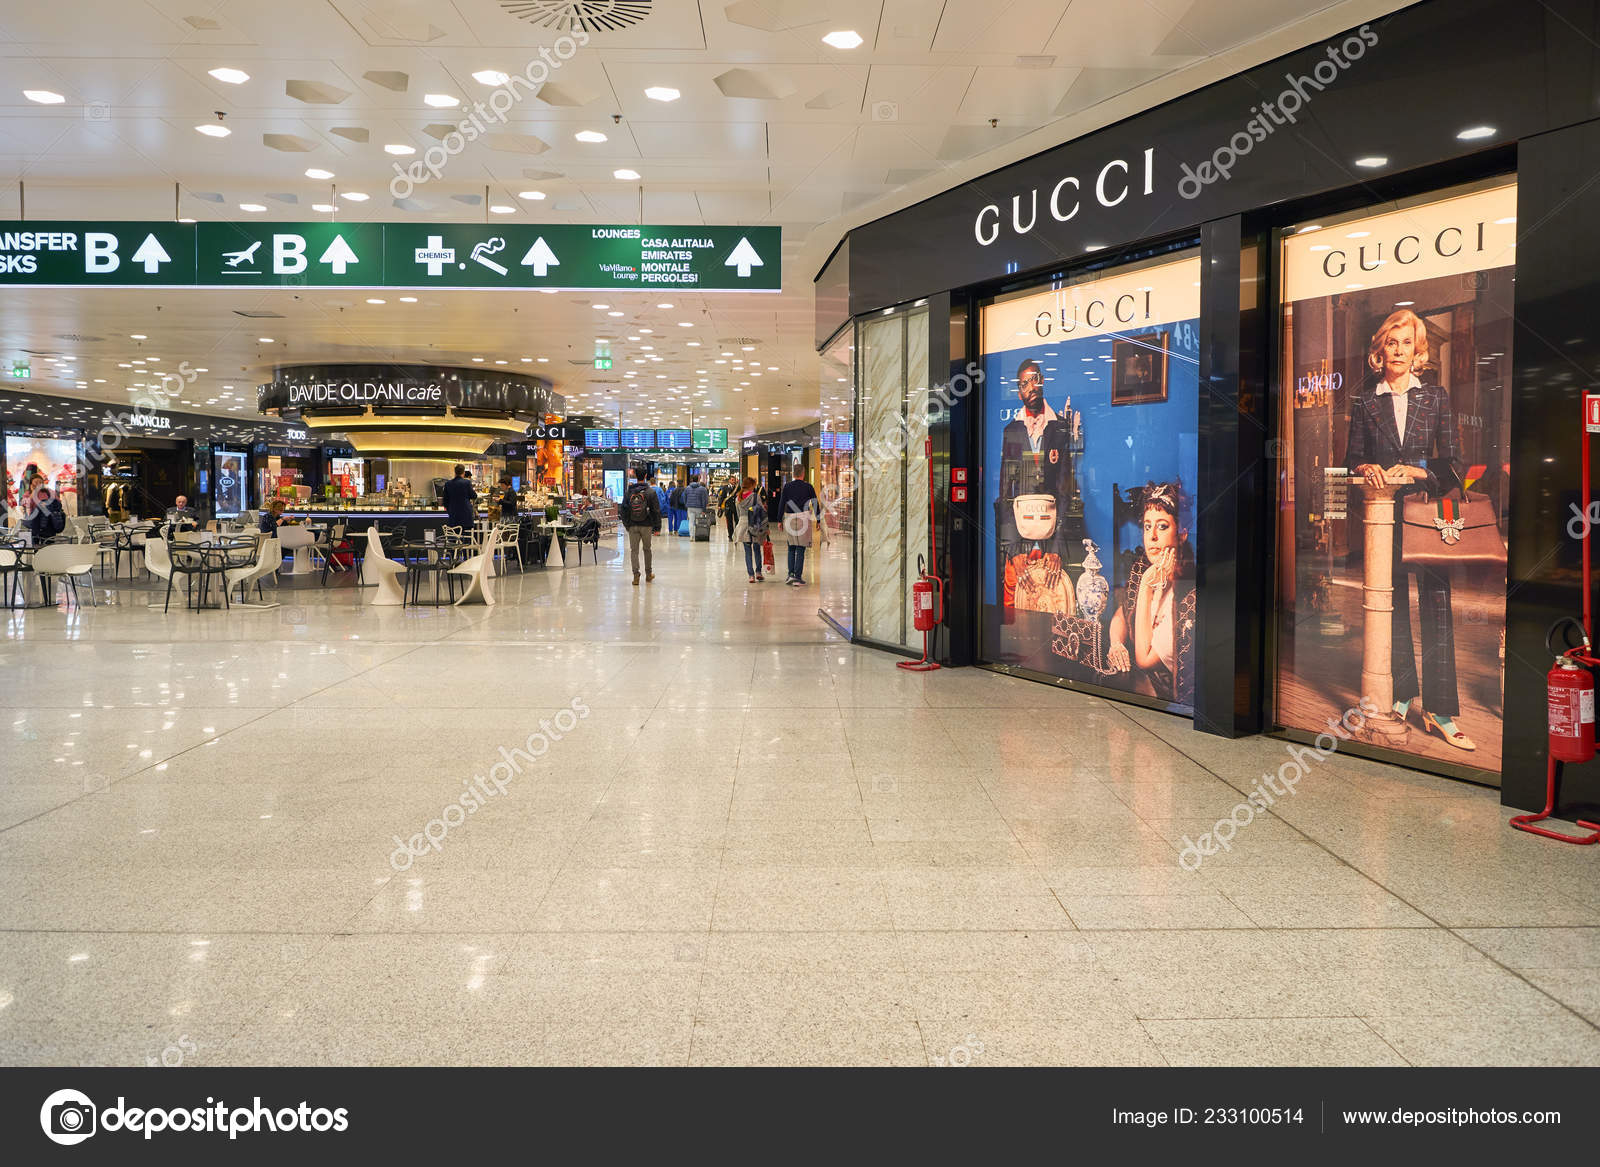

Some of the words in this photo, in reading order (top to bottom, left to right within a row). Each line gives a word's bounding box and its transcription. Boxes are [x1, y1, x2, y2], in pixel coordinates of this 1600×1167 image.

[975, 147, 1154, 246] GUCCI
[592, 229, 641, 239] LOUNGES
[641, 239, 669, 248] CASA
[671, 239, 714, 249] ALITALIA
[1322, 222, 1485, 278] GUCCI
[84, 232, 120, 274] B
[272, 234, 308, 275] B
[641, 251, 693, 260] EMIRATES
[641, 263, 690, 272] MONTALE
[613, 272, 638, 281] Lounge
[641, 273, 698, 283] PERGOLESI
[1035, 291, 1151, 337] GUCCI
[289, 384, 337, 402] DAVIDE
[340, 383, 404, 400] OLDANI
[406, 383, 442, 401] café
[130, 413, 170, 429] MONCLER
